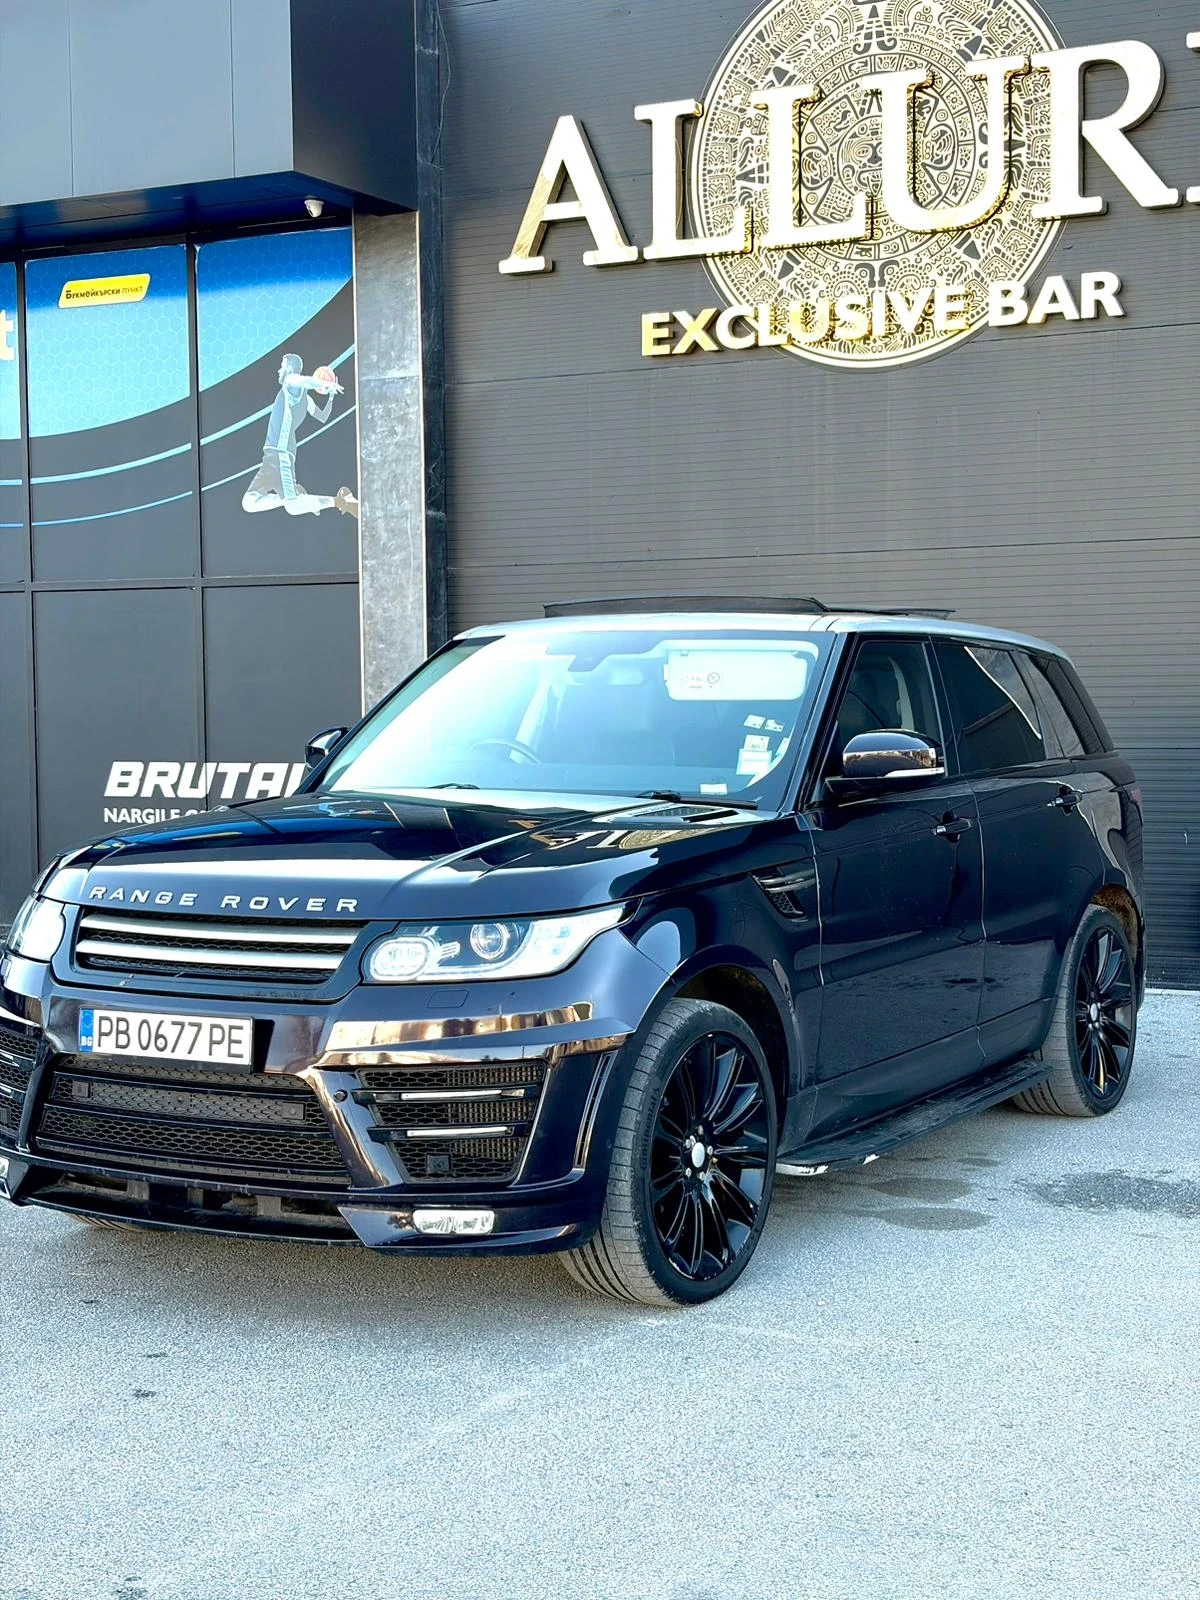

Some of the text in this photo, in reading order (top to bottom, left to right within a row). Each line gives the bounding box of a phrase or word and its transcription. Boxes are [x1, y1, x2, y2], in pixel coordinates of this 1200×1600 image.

[498, 32, 1200, 274] ALLUR
[641, 271, 1125, 358] EXCLUSIVE BAR
[89, 886, 359, 914] RANGE ROVER
[81, 1036, 93, 1047] BG
[97, 1015, 245, 1059] PB 0677 PE
